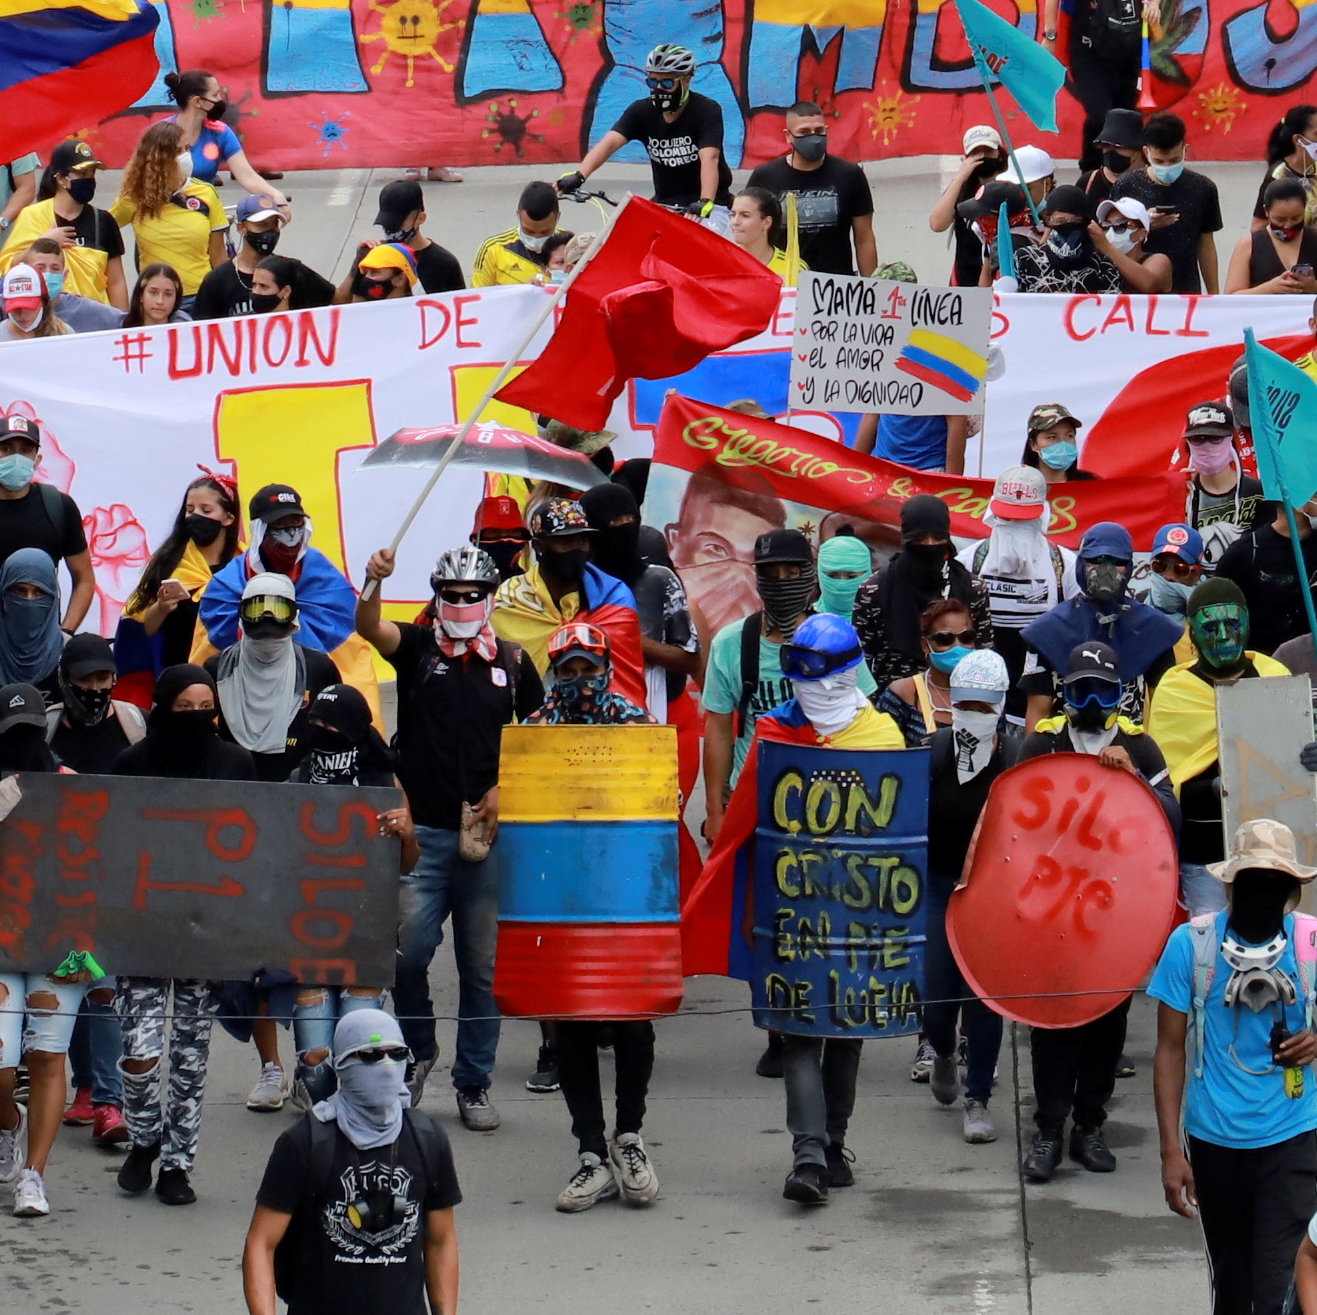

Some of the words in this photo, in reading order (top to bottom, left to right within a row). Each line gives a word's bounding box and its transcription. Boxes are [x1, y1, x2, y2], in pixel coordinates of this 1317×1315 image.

[647, 144, 699, 159] COLOMBIA
[659, 135, 692, 149] QUIERO
[661, 153, 699, 168] TOREO
[415, 294, 483, 350] DE
[1064, 293, 1210, 341] CALI
[812, 278, 878, 317] MAMÁ
[911, 288, 964, 327] LÍNEA
[811, 320, 839, 342] POR
[843, 322, 858, 344] LA
[860, 323, 894, 346] VIDA
[836, 346, 884, 372] AMOR
[824, 379, 840, 403] LA
[845, 380, 923, 408] DIGNIDAD
[773, 770, 899, 836] CON
[288, 799, 380, 984] SILOE
[775, 846, 919, 916] CRISTO
[774, 906, 831, 962] EN
[845, 920, 911, 974] PIE
[764, 972, 816, 1026] DE
